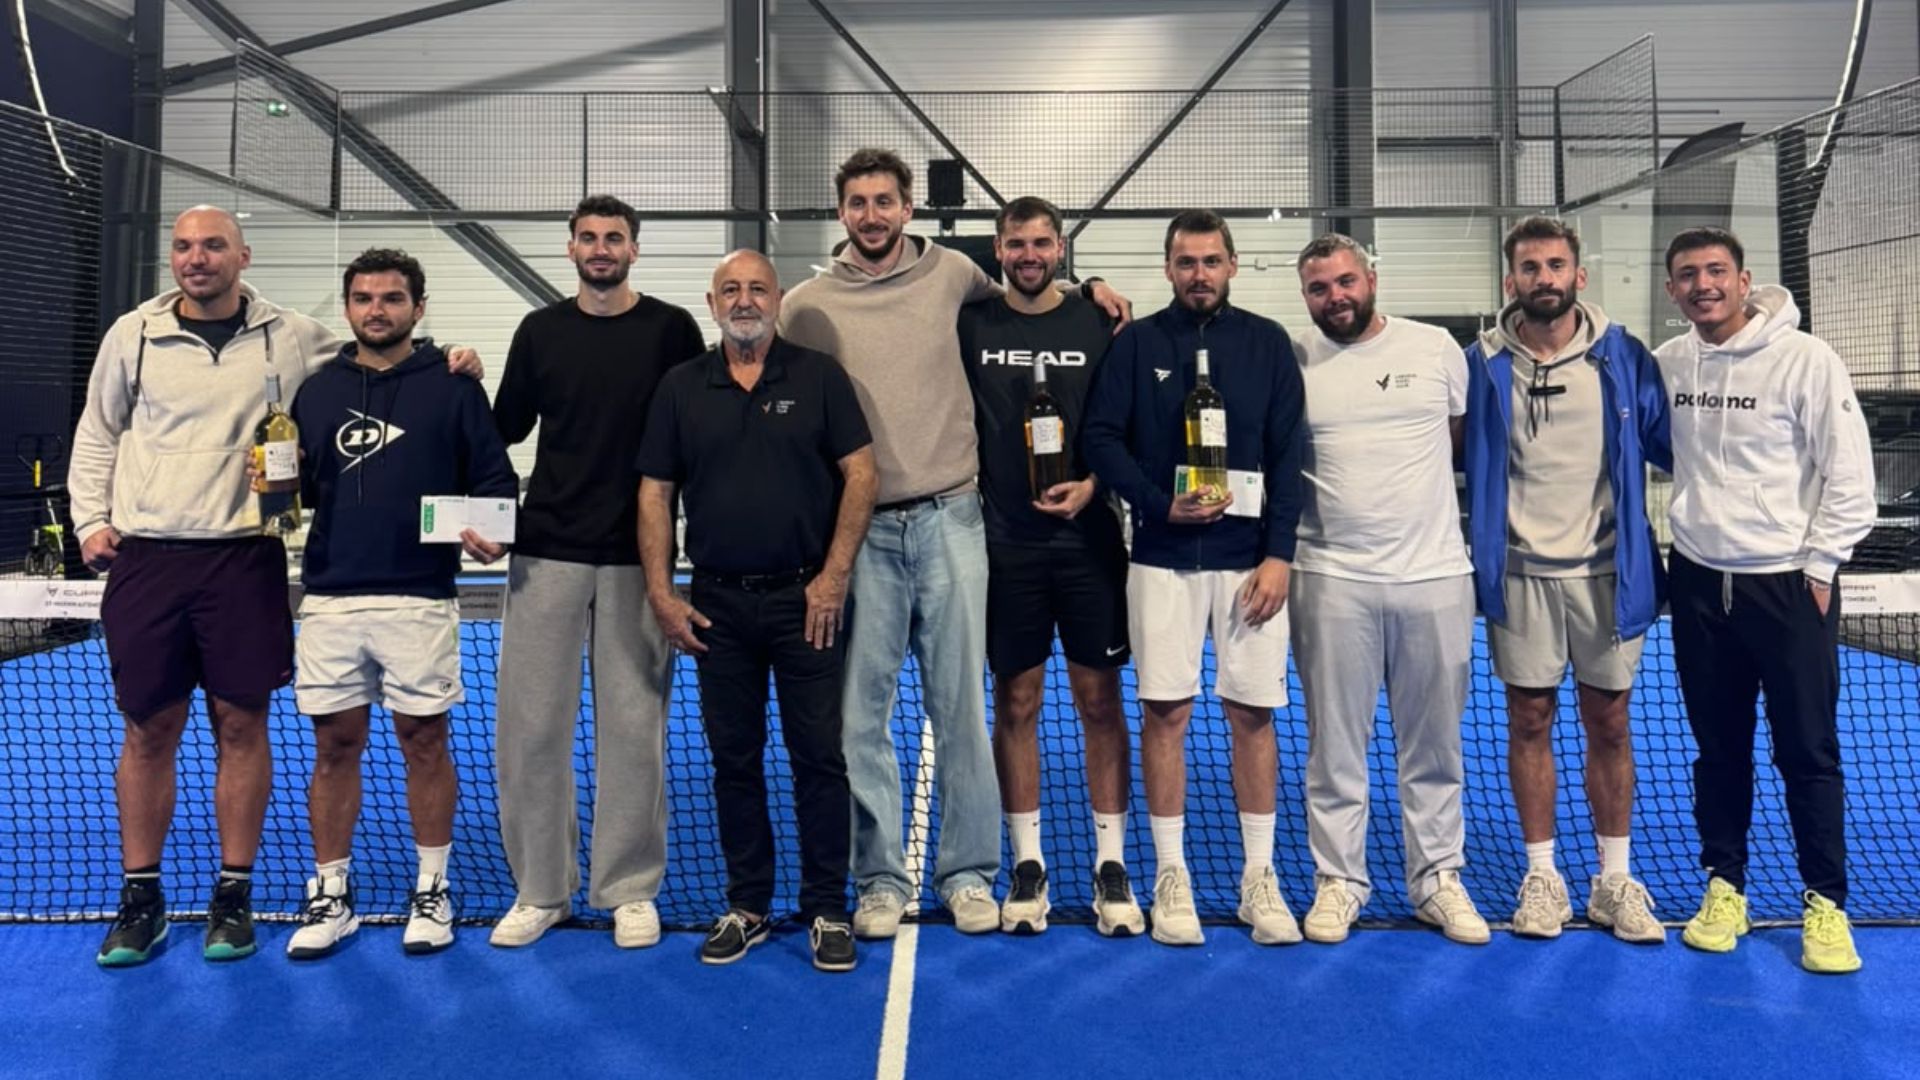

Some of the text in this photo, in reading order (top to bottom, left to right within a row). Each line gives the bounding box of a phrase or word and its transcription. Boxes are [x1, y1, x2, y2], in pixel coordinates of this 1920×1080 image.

[981, 349, 1087, 366] HEAD
[1674, 391, 1756, 410] paloma
[344, 428, 380, 447] D
[63, 589, 103, 597] CUPR
